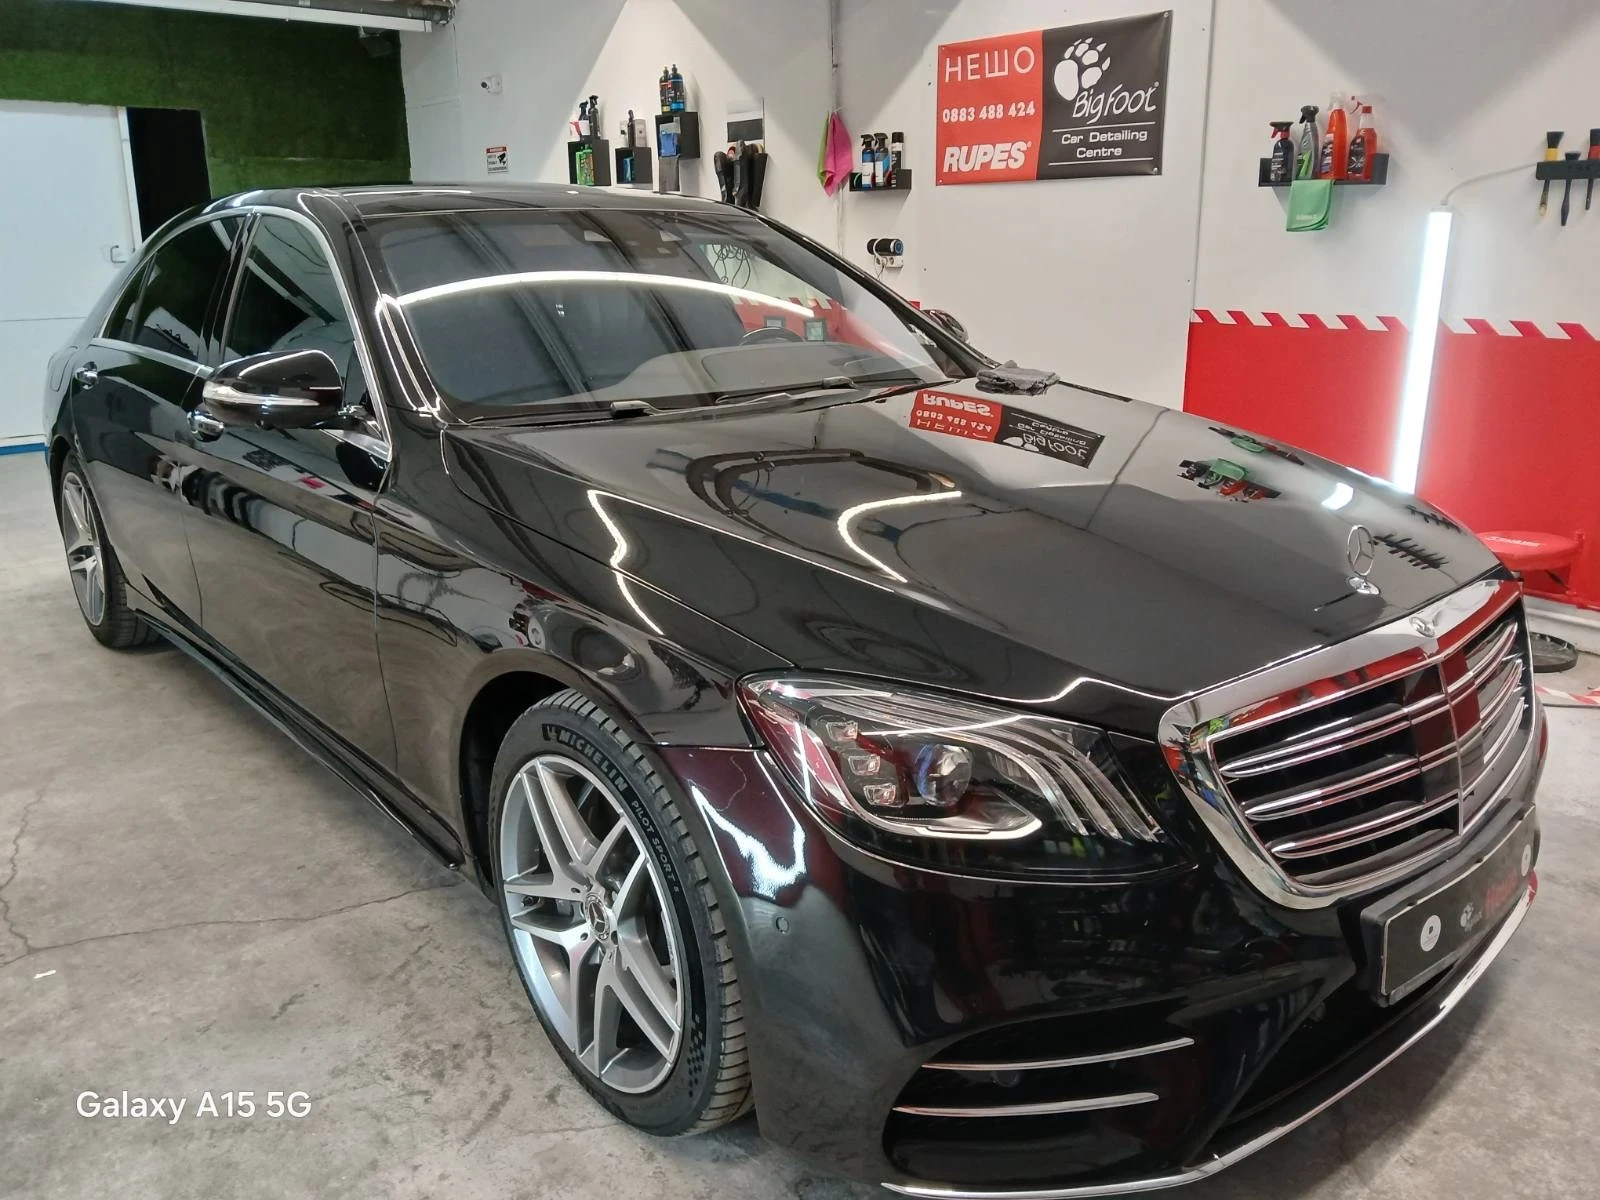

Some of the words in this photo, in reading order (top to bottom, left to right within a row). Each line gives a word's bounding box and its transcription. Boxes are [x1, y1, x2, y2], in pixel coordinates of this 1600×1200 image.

[945, 46, 1035, 83] НЕШО
[943, 107, 975, 123] 0883
[979, 103, 1004, 120] 488
[1008, 100, 1035, 118] 424
[1061, 133, 1084, 145] Car
[1089, 129, 1148, 143] Detailing
[1076, 147, 1122, 158] Centre
[943, 141, 1028, 173] RUPES
[558, 730, 629, 792] MICHELIN
[631, 801, 655, 834] PILOT
[651, 837, 676, 882] SPORT
